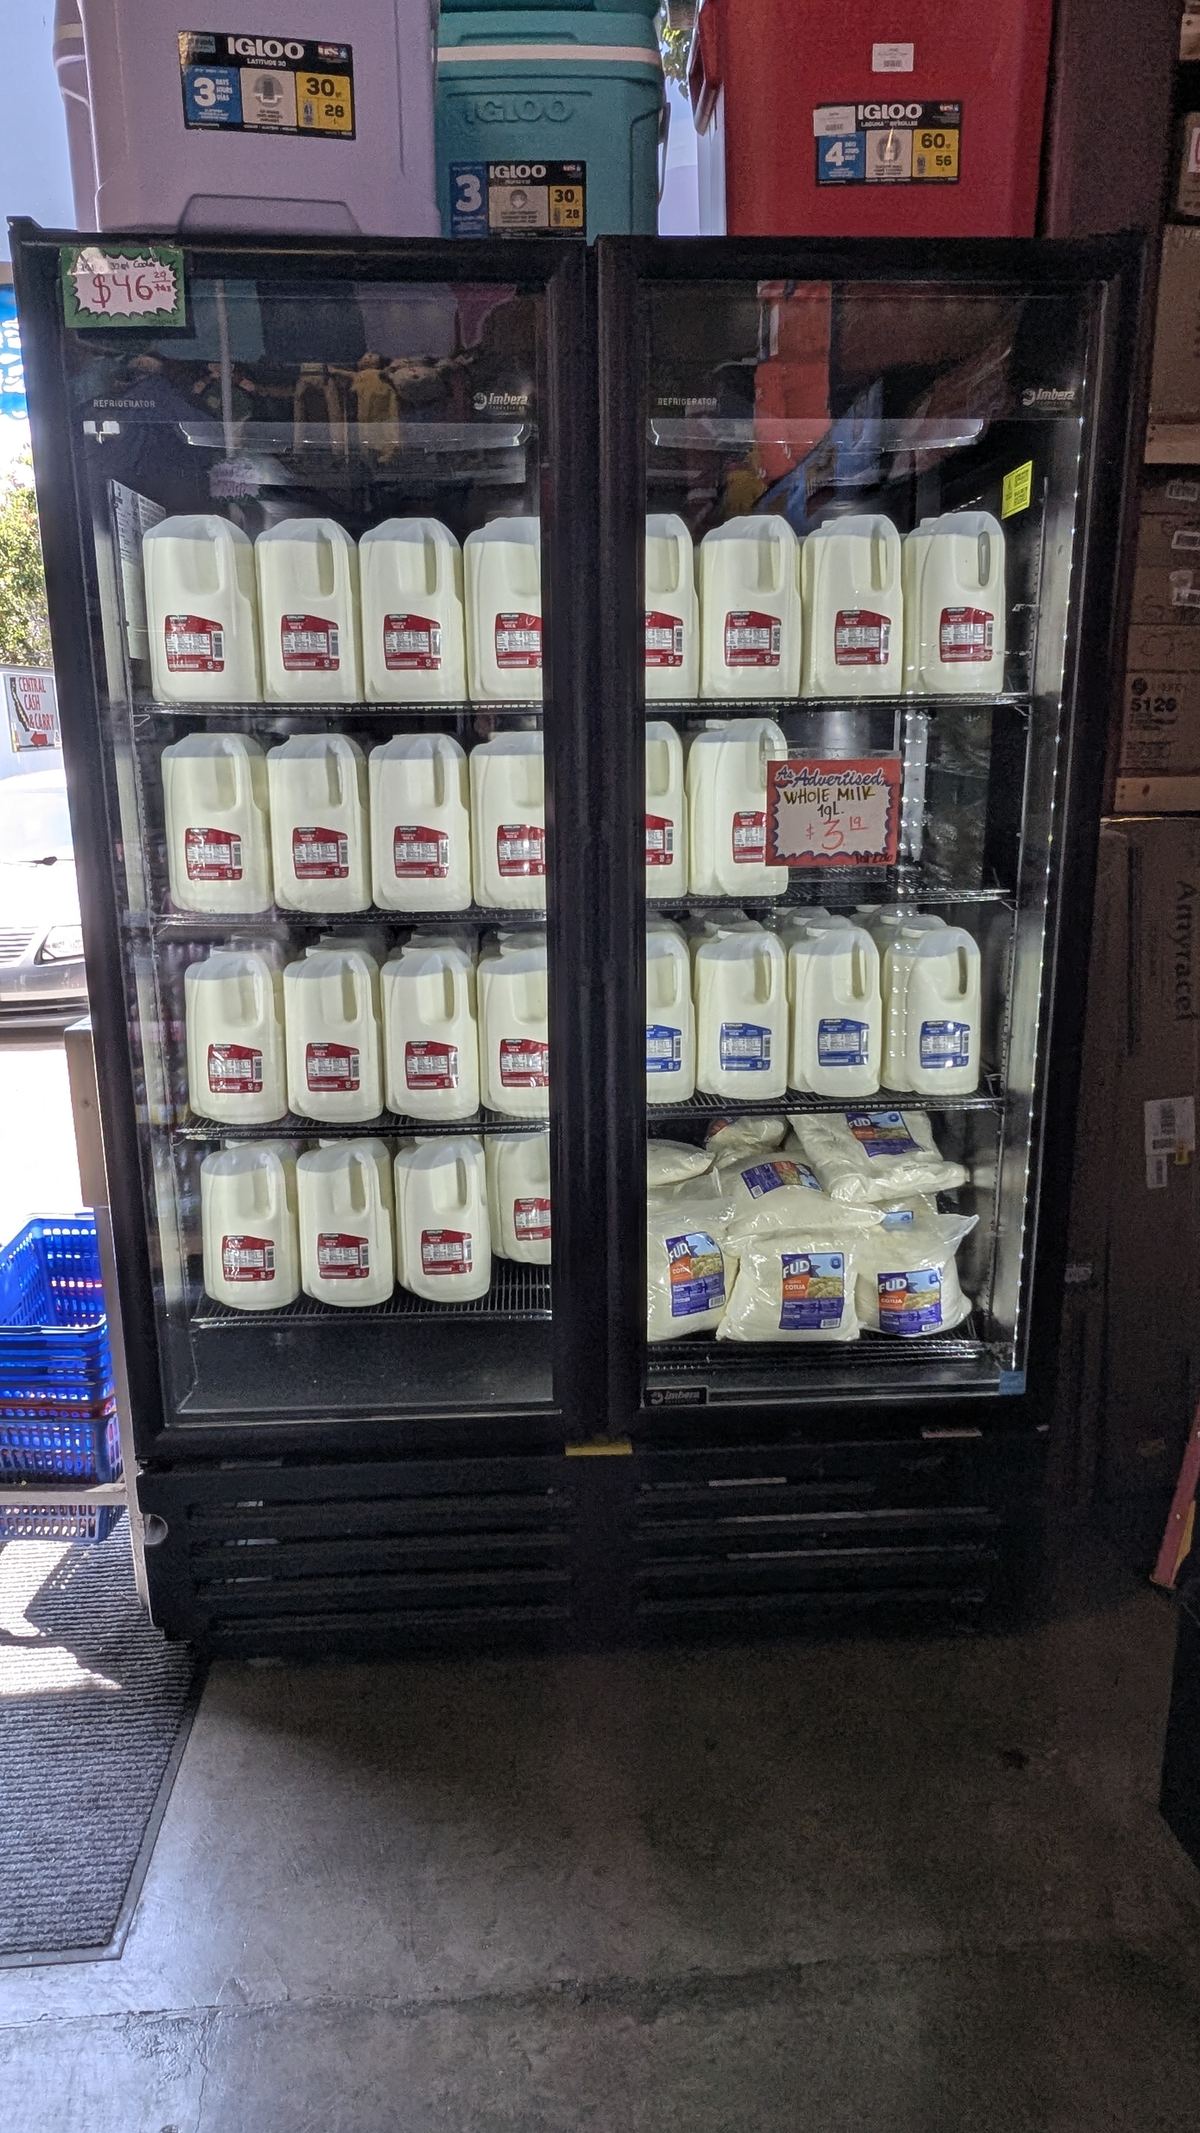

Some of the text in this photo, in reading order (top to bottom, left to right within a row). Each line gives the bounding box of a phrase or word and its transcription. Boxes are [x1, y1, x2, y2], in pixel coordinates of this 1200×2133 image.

[227, 37, 305, 59] IGLOO
[247, 58, 277, 66] LATITUDE
[193, 77, 216, 107] 3
[306, 77, 335, 97] 30
[324, 104, 345, 117] 28
[857, 104, 923, 120] IGLOO
[921, 133, 945, 149] 60
[825, 141, 845, 167] 4
[935, 155, 952, 167] 56
[489, 164, 547, 179] IGLOO
[455, 174, 482, 213] 3
[554, 189, 575, 203] 30
[565, 209, 580, 219] 28
[92, 273, 154, 309] $46
[93, 399, 156, 408] REFRIGERATOR
[657, 397, 718, 407] REFRIGERATOR
[19, 677, 46, 693] CENTRAL
[24, 694, 41, 711] CASH
[776, 765, 883, 787] As Advertised
[848, 1117, 871, 1129] FUD
[669, 1242, 692, 1264] FUD
[783, 1260, 810, 1279] FUD
[879, 1278, 907, 1293] FUD
